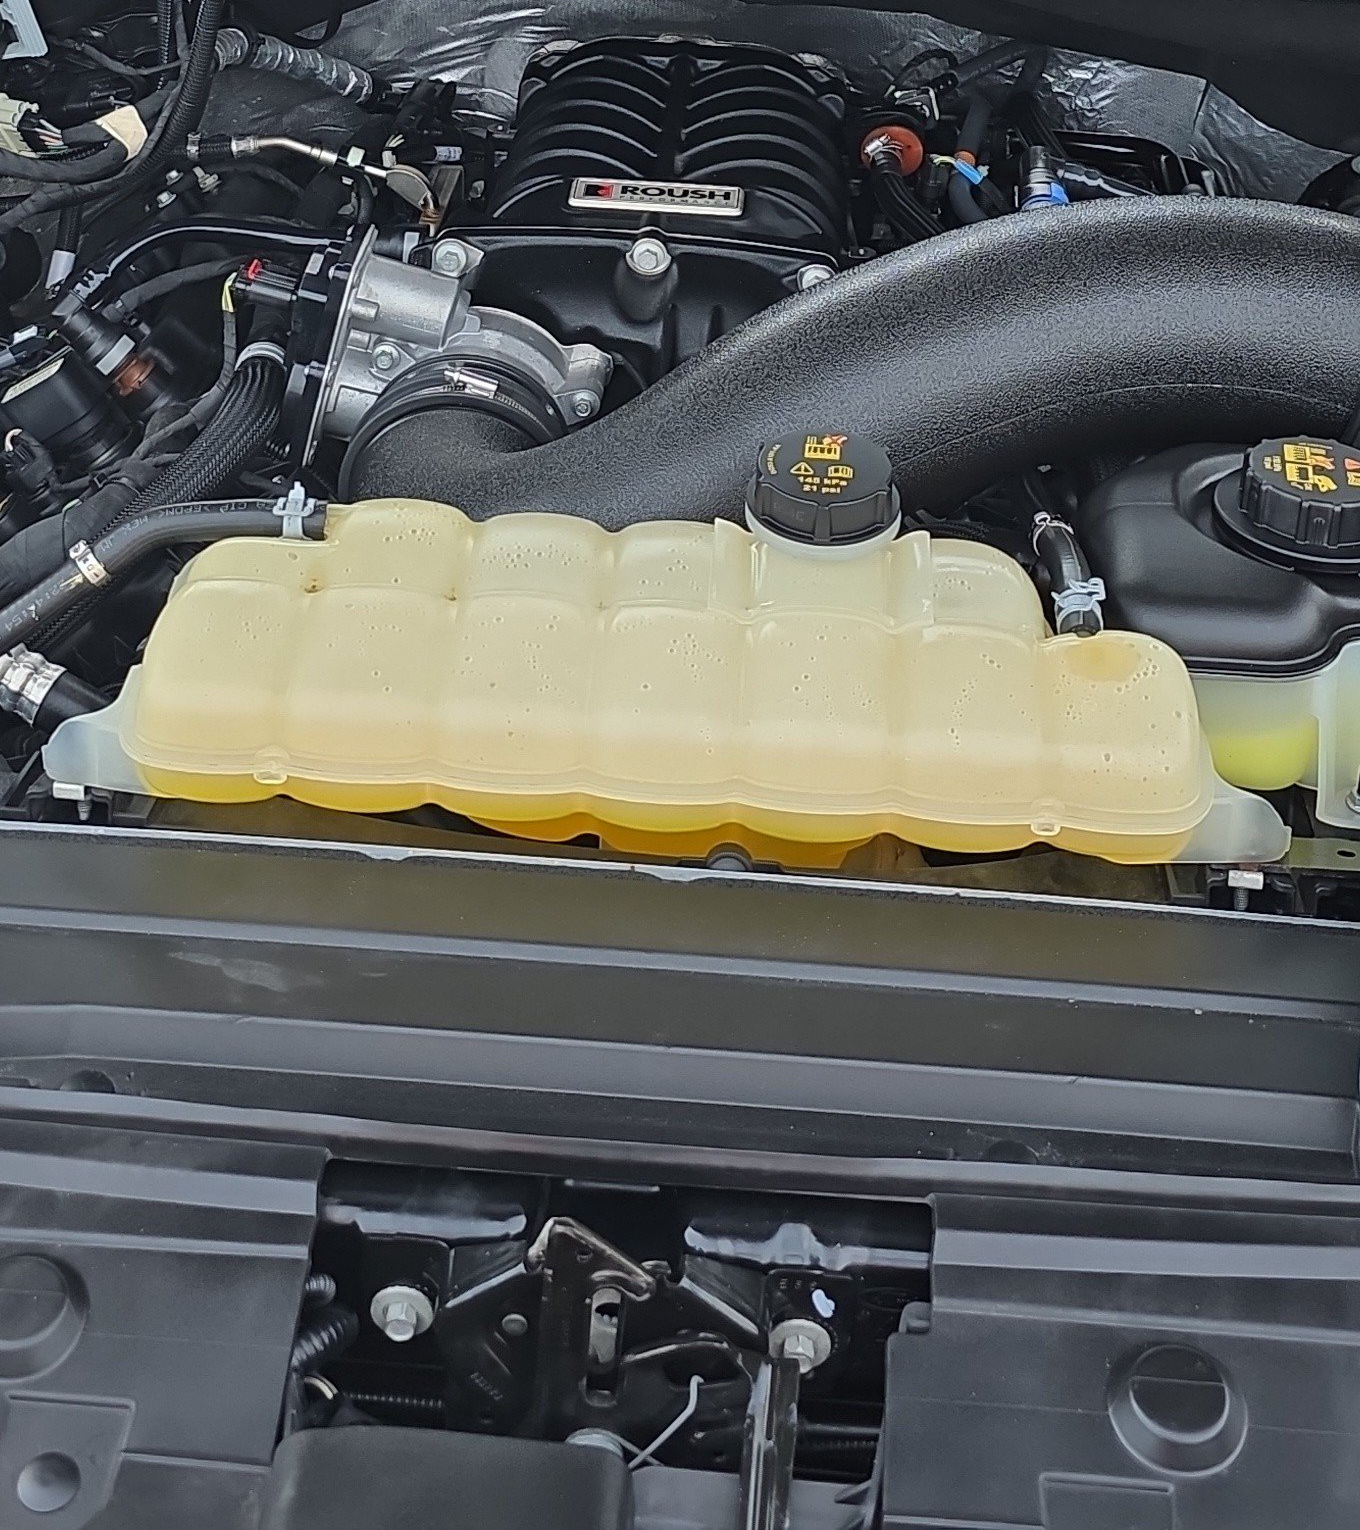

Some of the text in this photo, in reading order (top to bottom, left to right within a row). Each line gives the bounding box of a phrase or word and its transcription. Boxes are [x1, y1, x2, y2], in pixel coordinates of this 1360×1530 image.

[621, 186, 731, 200] ROUSH
[823, 477, 848, 486] kPa
[821, 486, 841, 494] psi
